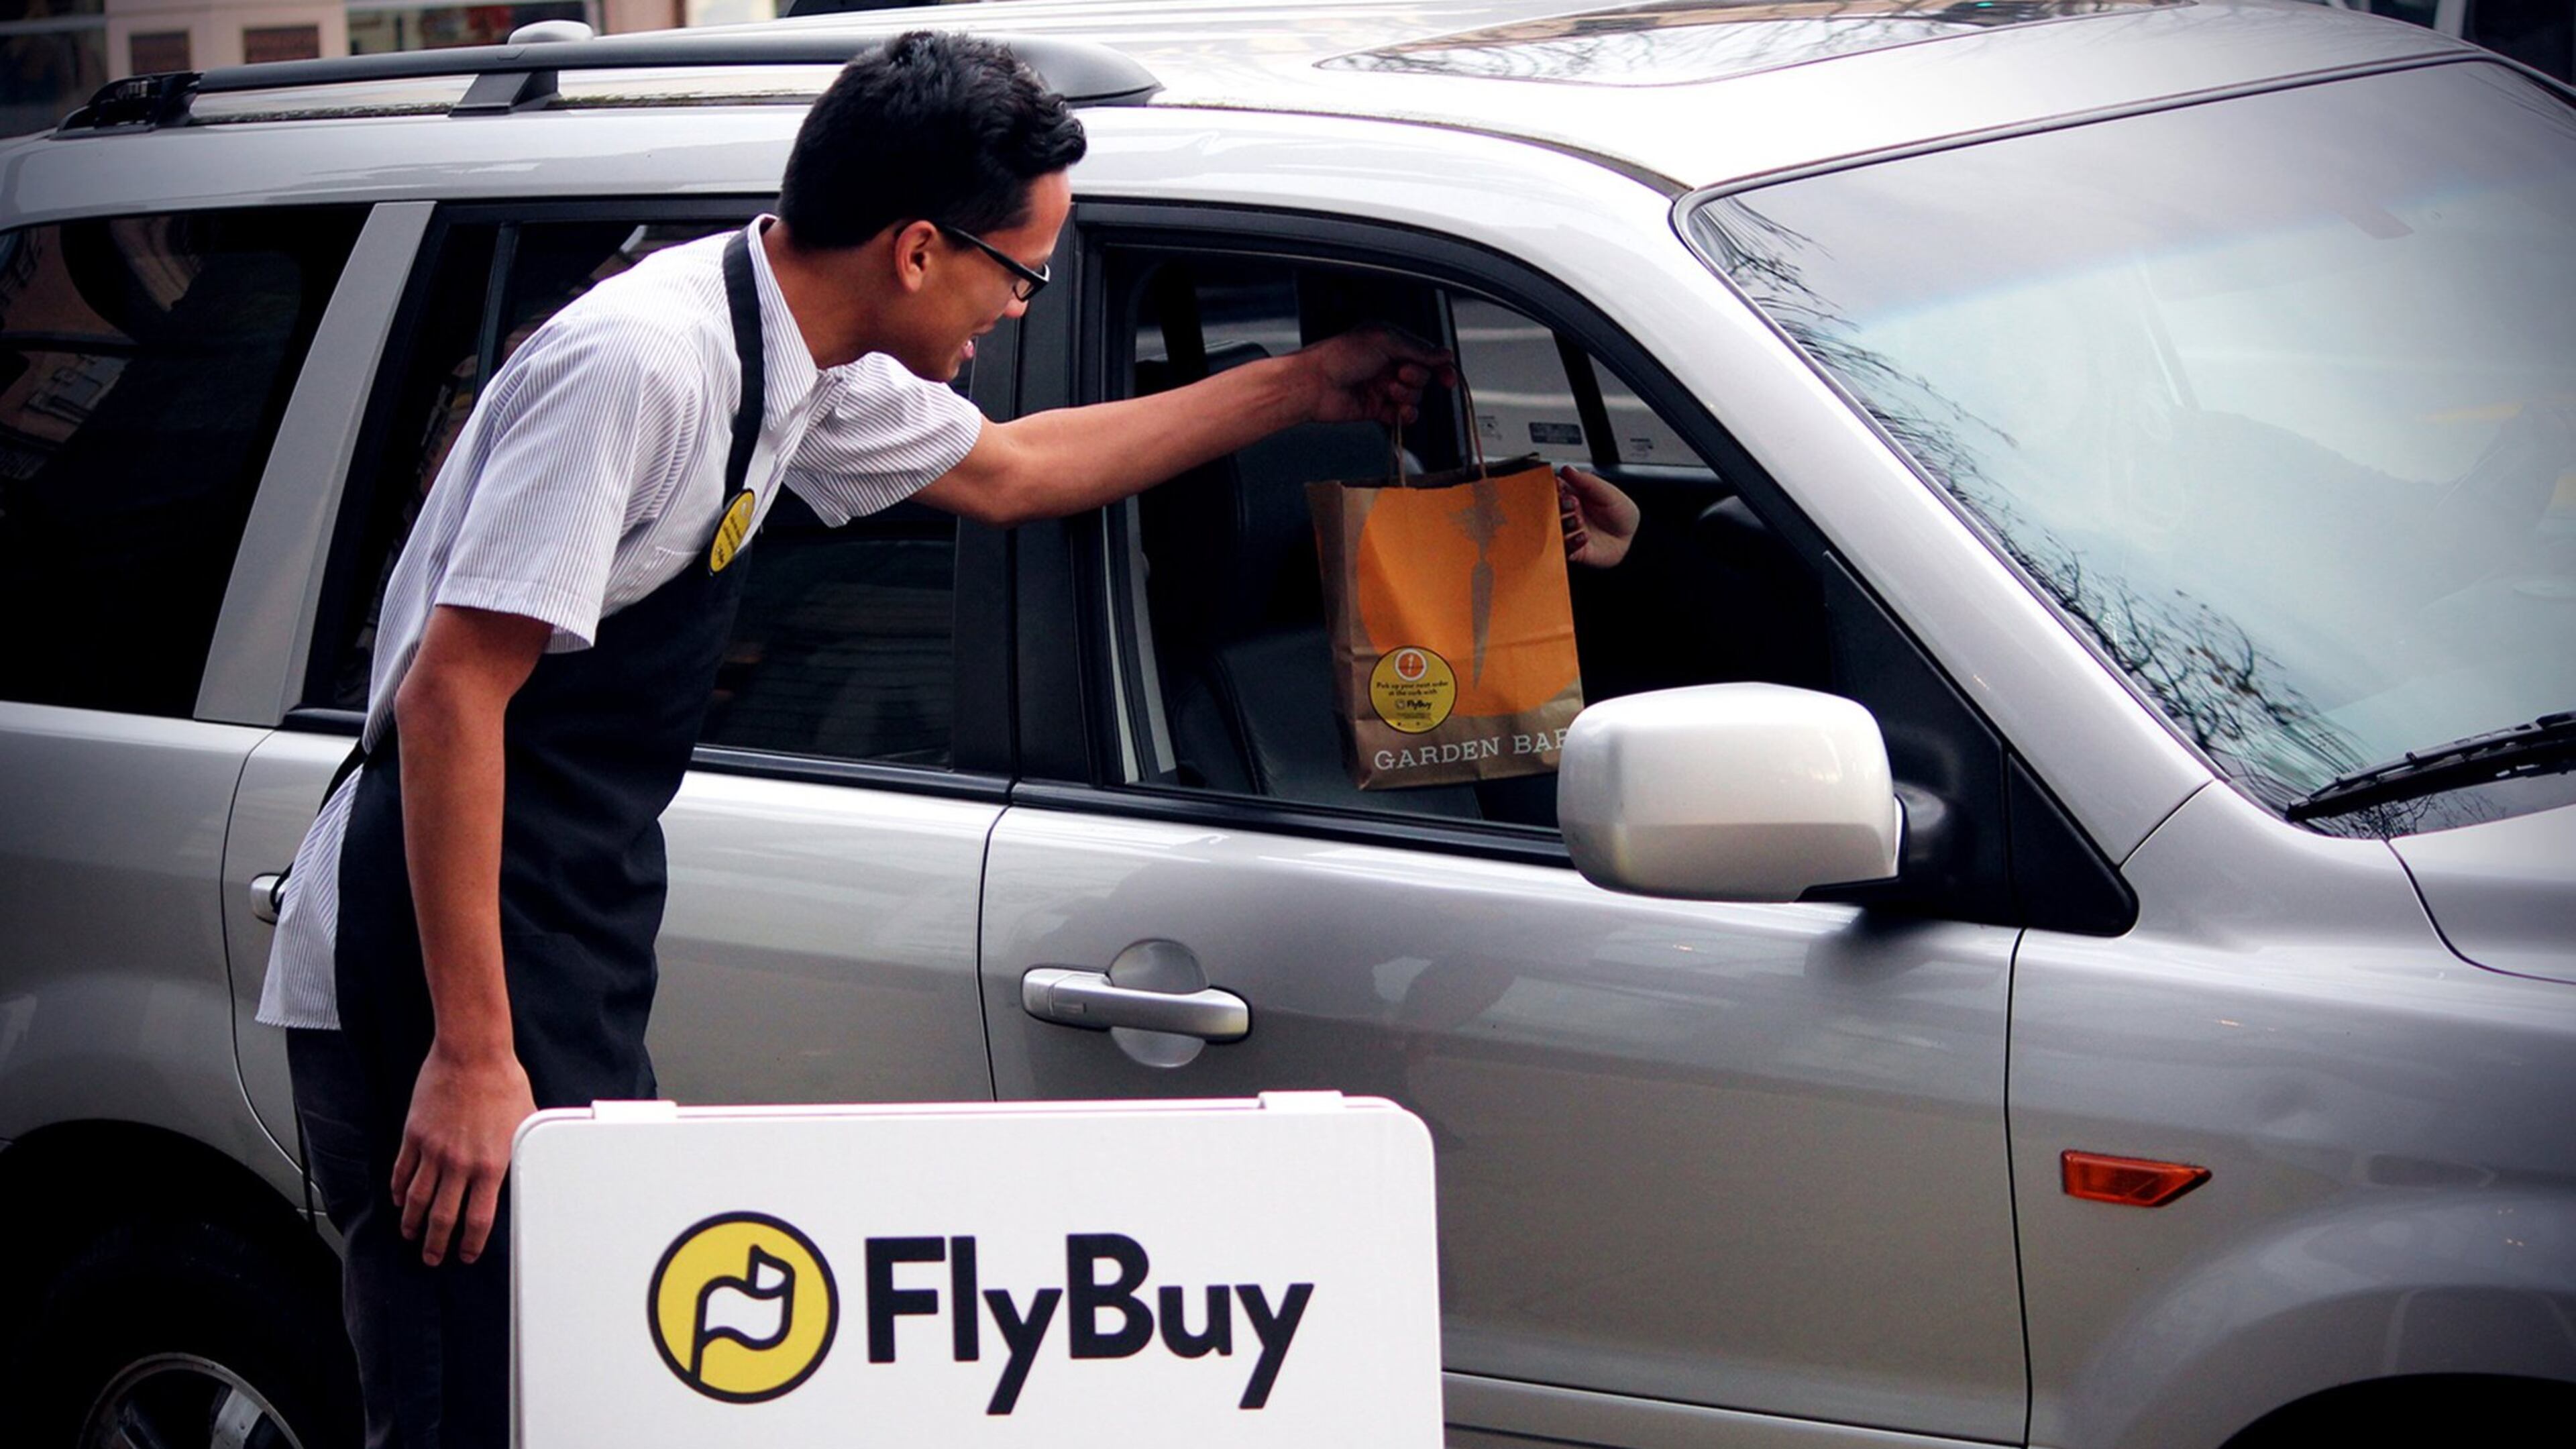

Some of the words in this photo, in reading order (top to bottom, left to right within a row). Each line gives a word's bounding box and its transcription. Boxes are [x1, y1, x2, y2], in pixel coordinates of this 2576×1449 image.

[1407, 700, 1432, 710] FlyBuy
[1374, 737, 1500, 770] GARDEN
[865, 1234, 1313, 1415] FlyBuy
